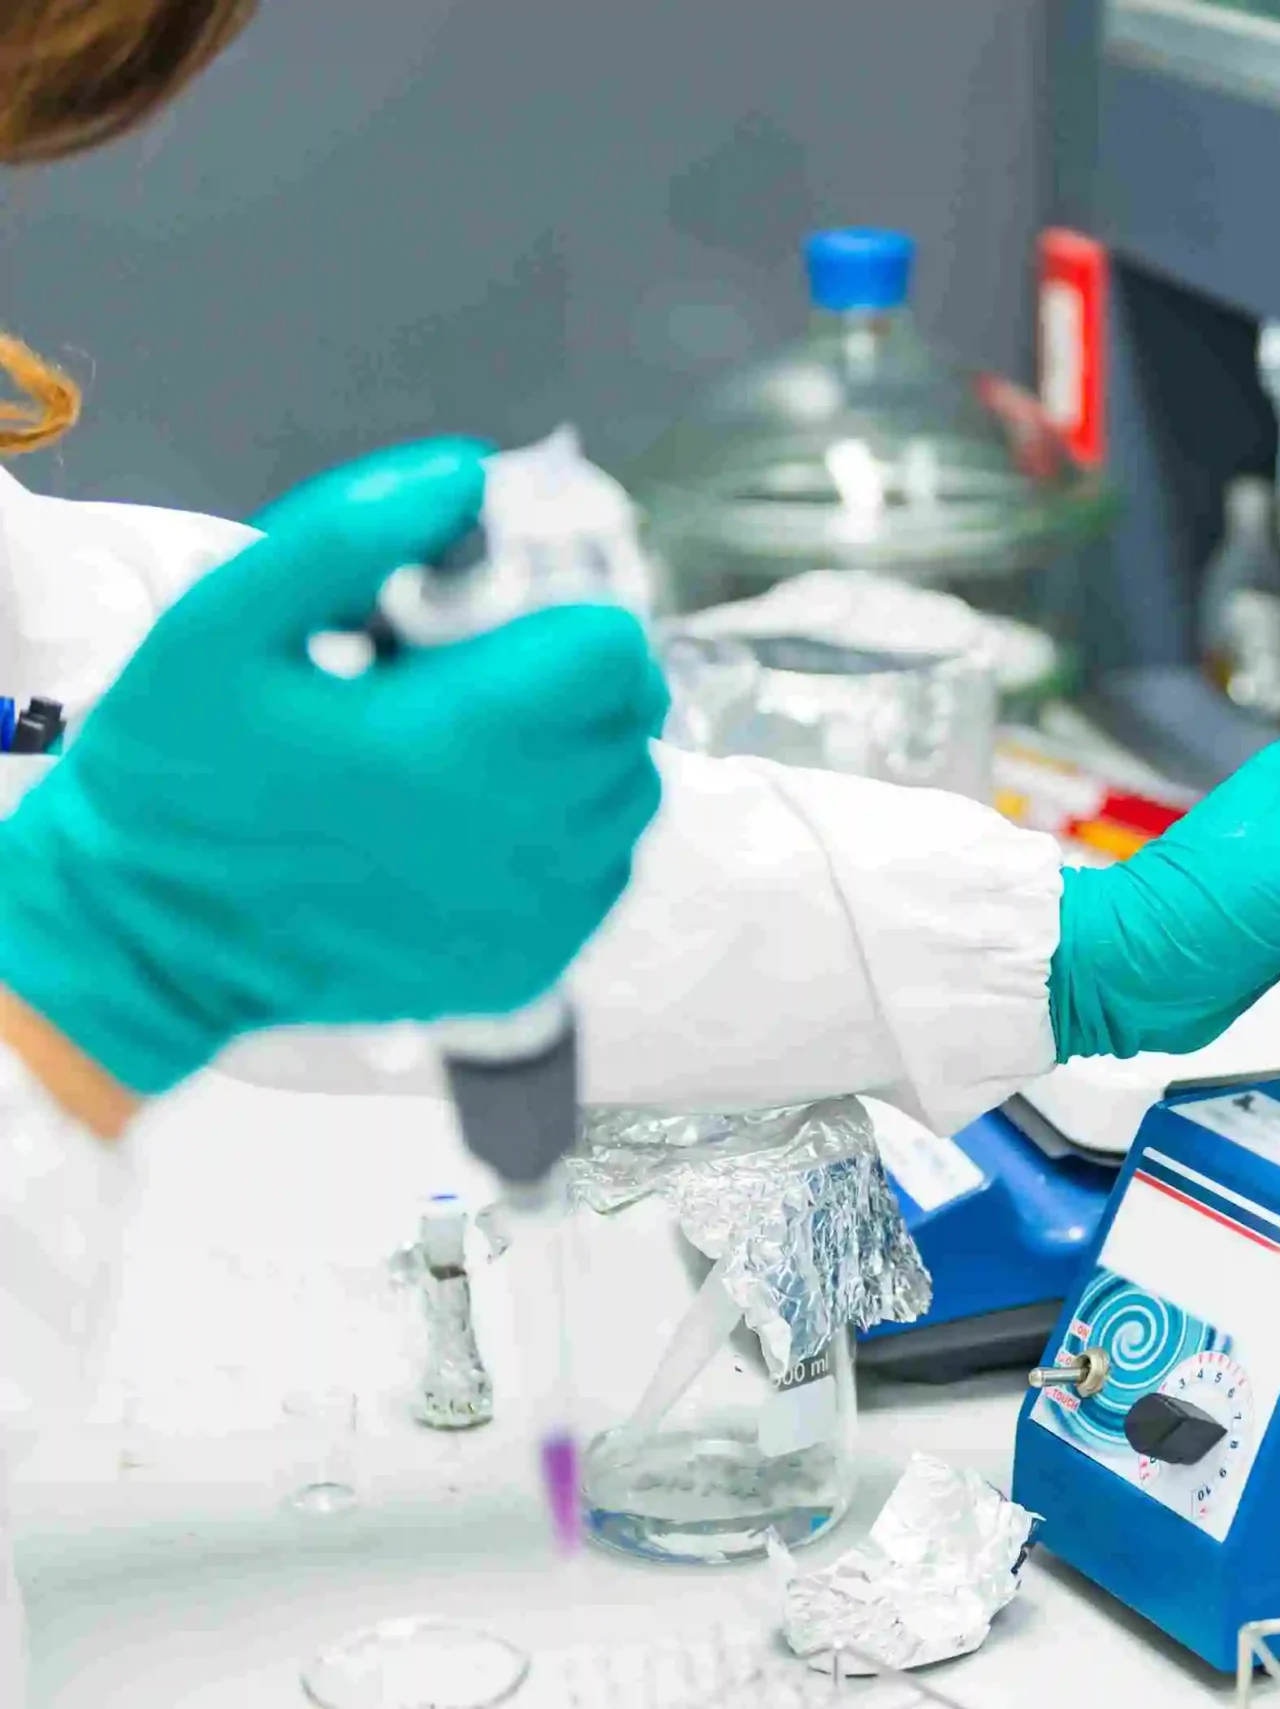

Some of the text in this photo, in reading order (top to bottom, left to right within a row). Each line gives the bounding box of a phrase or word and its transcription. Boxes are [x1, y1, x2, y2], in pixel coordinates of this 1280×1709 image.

[1197, 1369, 1203, 1379] 4
[1214, 1372, 1222, 1383] 5
[1180, 1379, 1185, 1389] 3
[1227, 1387, 1235, 1398] 6
[1053, 1388, 1079, 1411] TOUCH
[1234, 1412, 1242, 1420] 7
[1219, 1468, 1227, 1478] 9
[1197, 1486, 1211, 1501] 10
